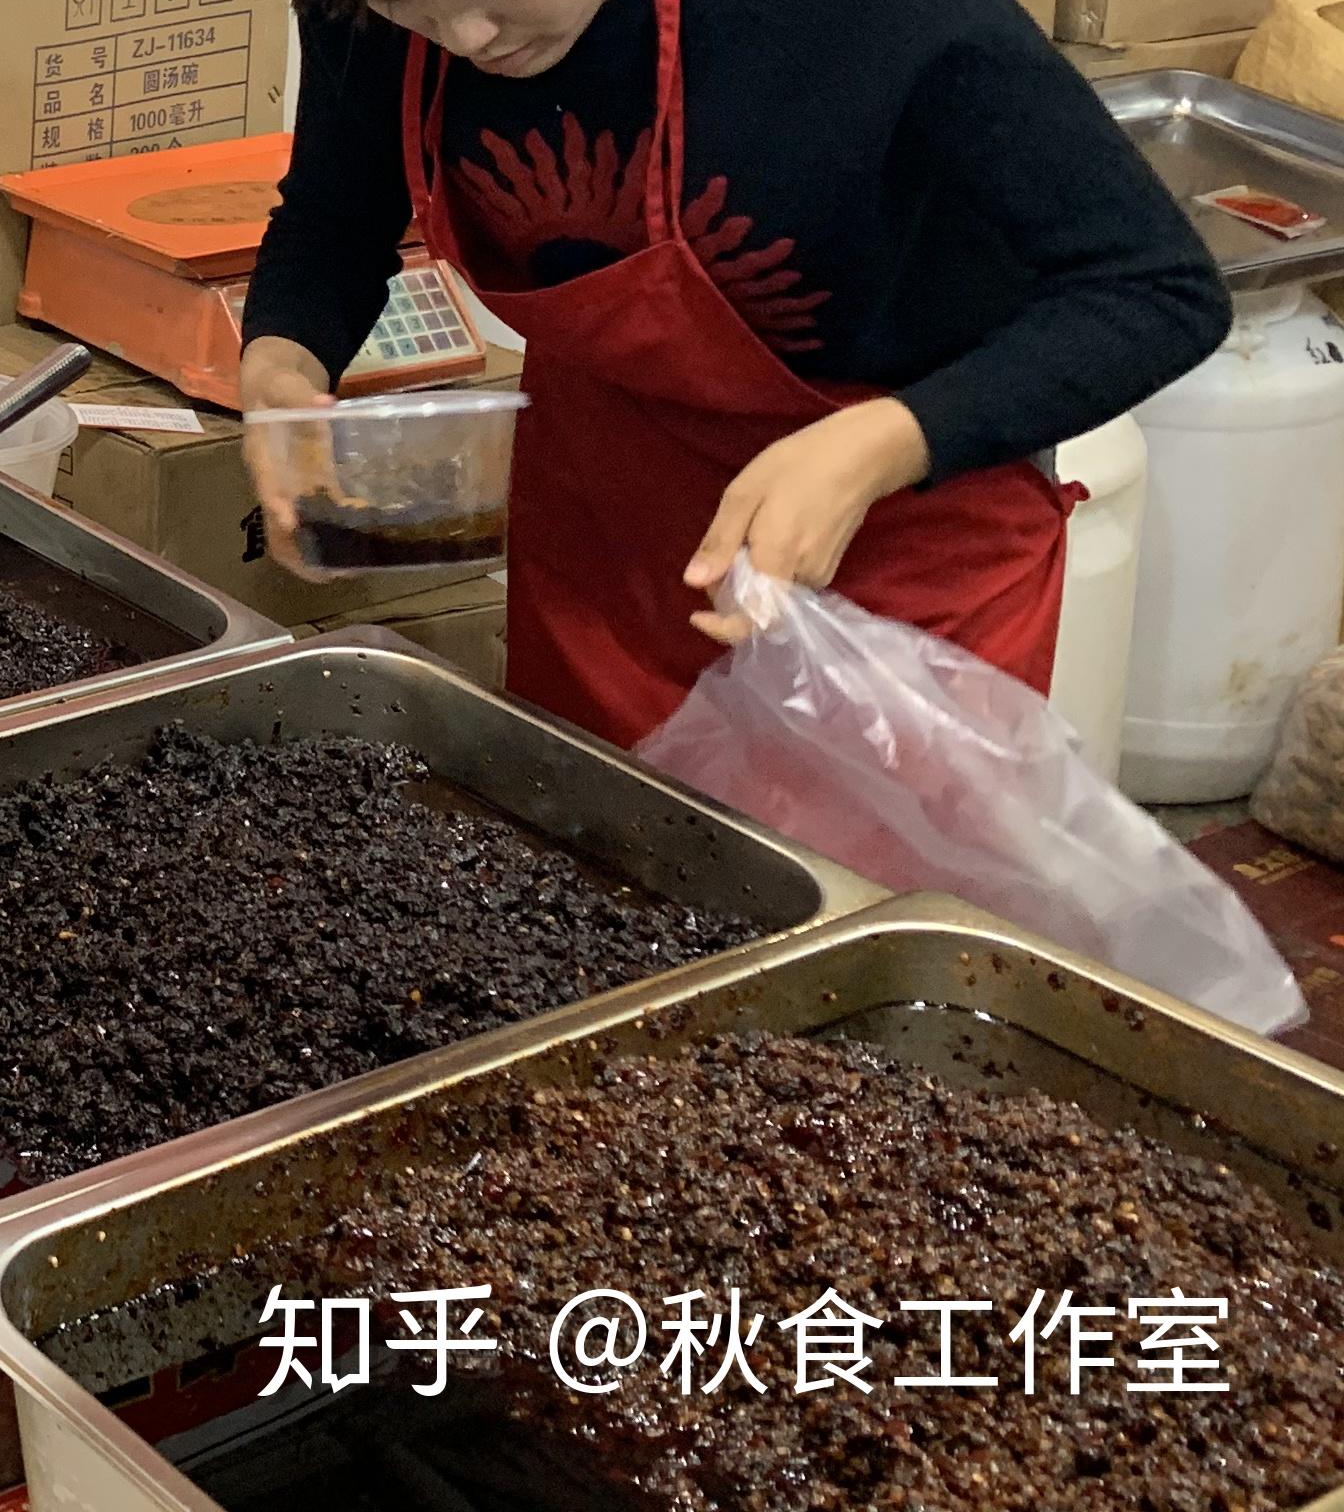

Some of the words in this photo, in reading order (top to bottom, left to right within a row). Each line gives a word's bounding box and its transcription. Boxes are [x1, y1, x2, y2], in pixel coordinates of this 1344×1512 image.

[131, 26, 216, 59] ZJ-11634
[143, 62, 199, 94] 圆汤碗
[129, 98, 204, 133] 1000毫升
